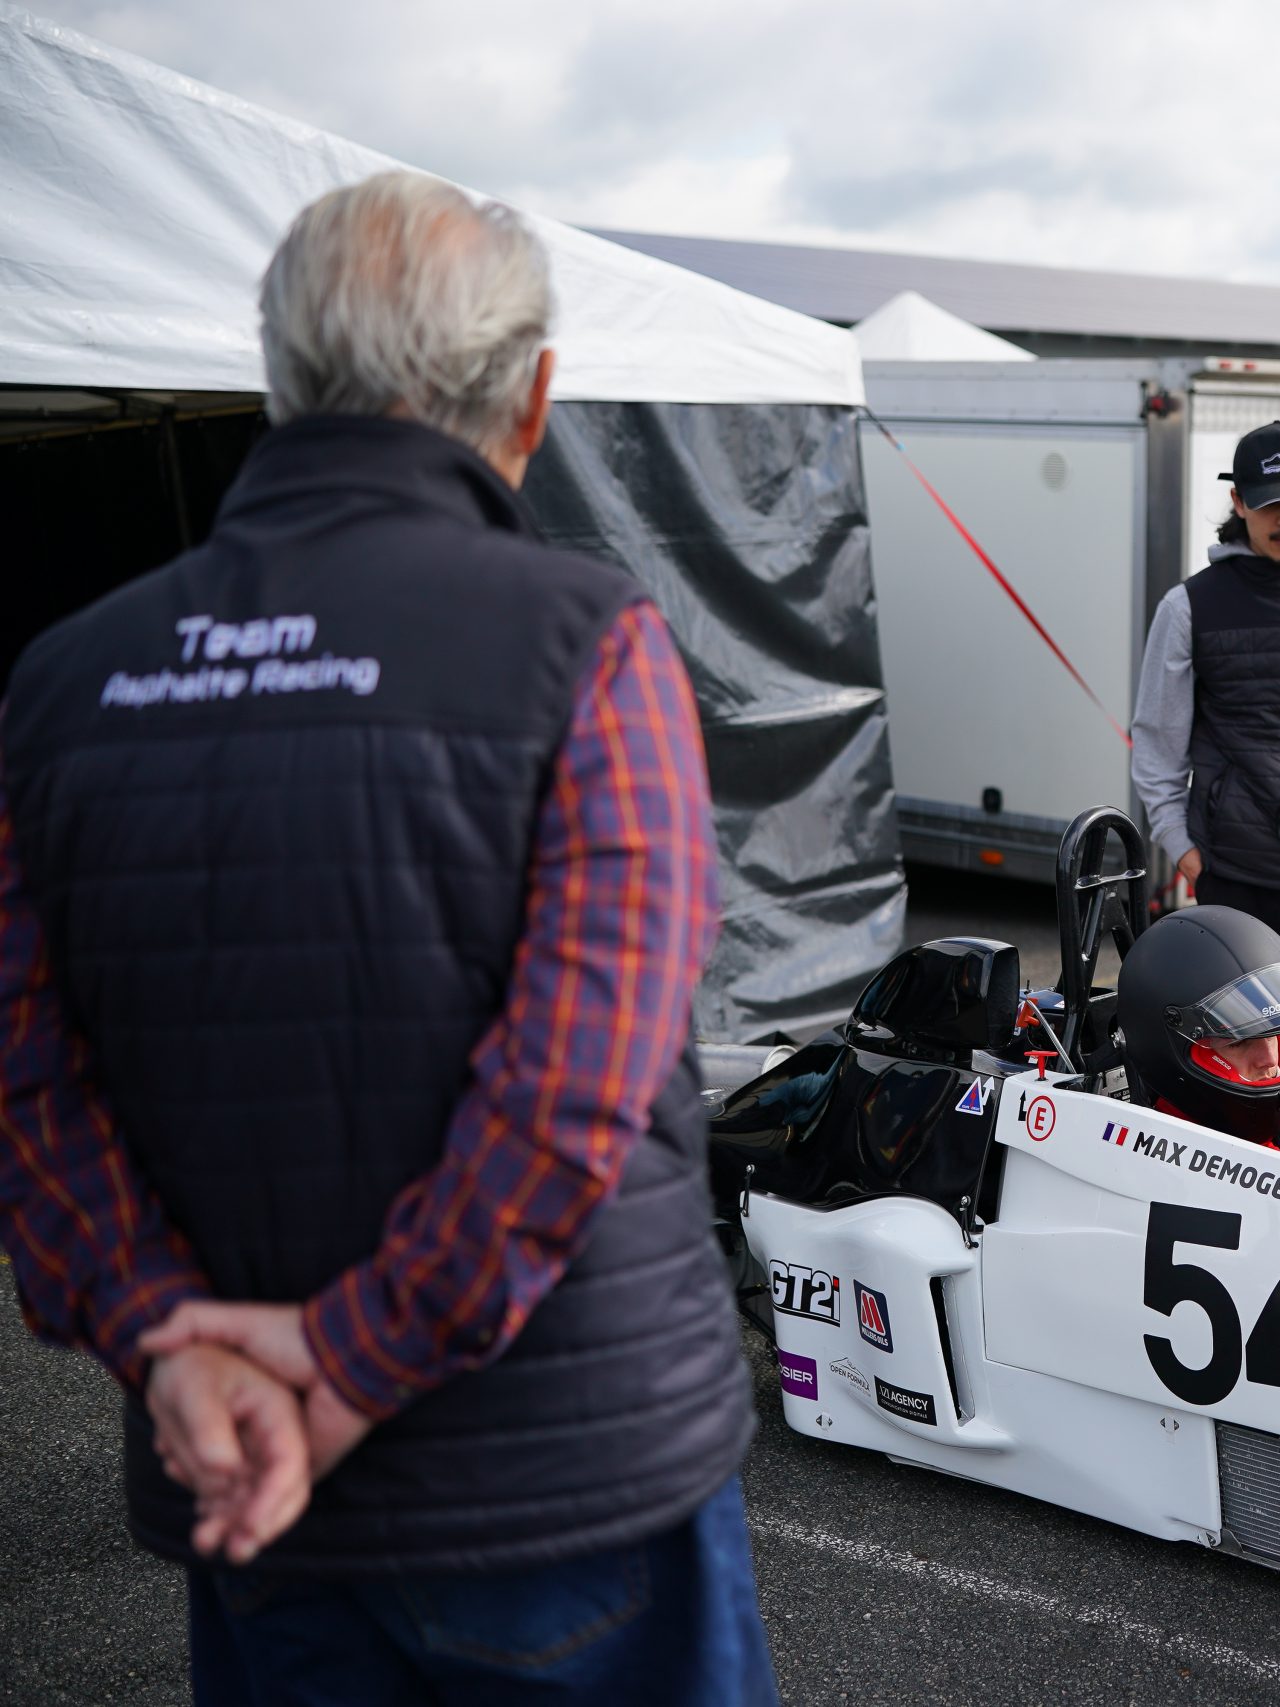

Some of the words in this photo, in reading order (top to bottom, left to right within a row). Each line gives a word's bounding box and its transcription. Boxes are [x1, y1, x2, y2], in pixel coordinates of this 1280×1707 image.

[176, 614, 317, 664] Team
[101, 664, 249, 710] Asphalte
[252, 650, 381, 696] Racing
[1034, 1106, 1047, 1131] E
[1132, 1131, 1188, 1167] MAX
[769, 1258, 840, 1323] GT2i
[830, 1364, 847, 1377] OPEN
[847, 1371, 870, 1391] FORMULA
[891, 1391, 928, 1411] AGENCY
